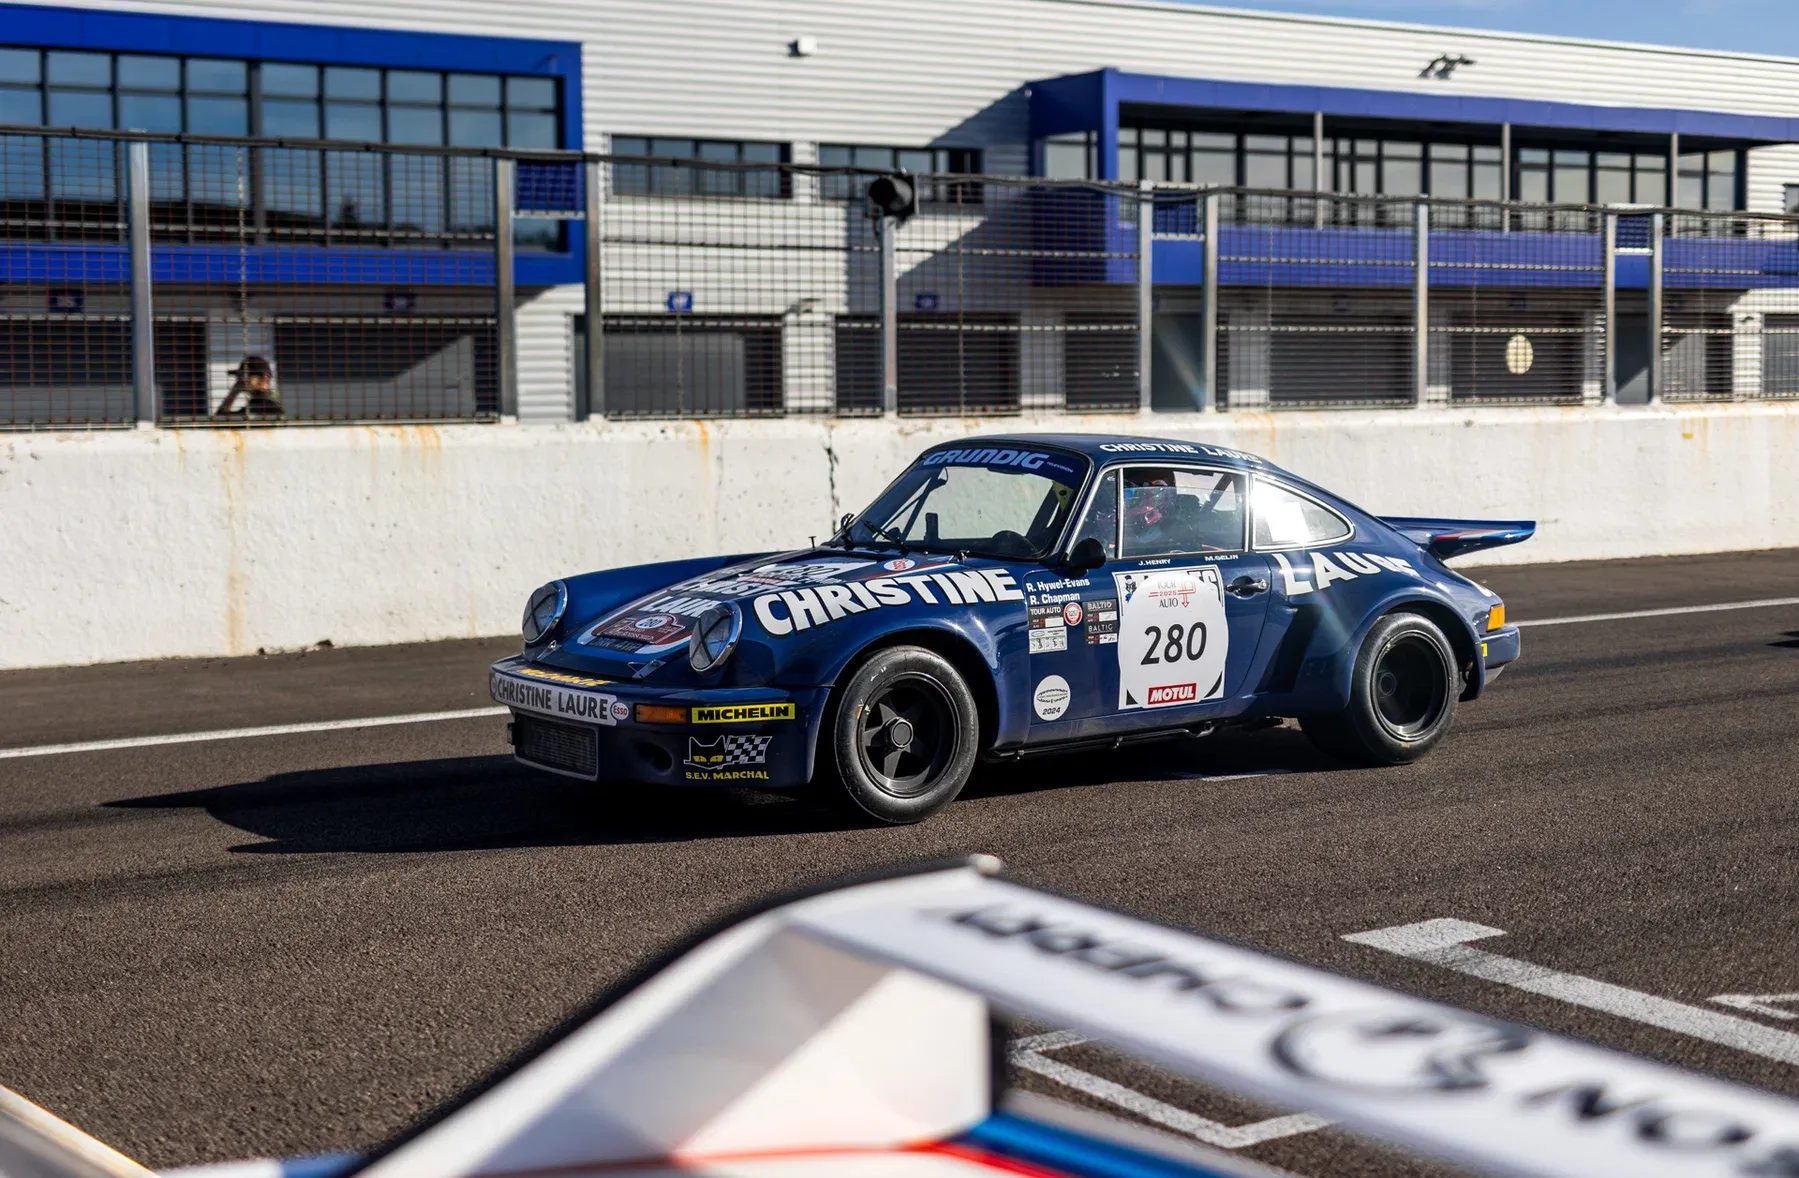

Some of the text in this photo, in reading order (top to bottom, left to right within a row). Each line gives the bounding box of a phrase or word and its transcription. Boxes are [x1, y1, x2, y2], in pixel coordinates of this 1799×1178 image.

[1099, 443, 1199, 454] CHRISTINE
[922, 448, 1050, 470] GRUNDIG
[1026, 578, 1090, 592] R. Hywel-Evans
[754, 568, 1025, 636] CHRISTINE
[1030, 593, 1080, 605] R. Chapman
[1159, 598, 1178, 608] AUTO
[1030, 606, 1061, 616] TOUR AUTO
[1140, 621, 1207, 665] 280
[497, 678, 552, 710] CHRISTINE
[559, 692, 609, 720] LAURE
[1150, 686, 1194, 703] MOTUL
[698, 706, 789, 720] MICHELIN
[1042, 707, 1061, 715] 2024
[686, 771, 770, 780] S.E.V. MARCHAL
